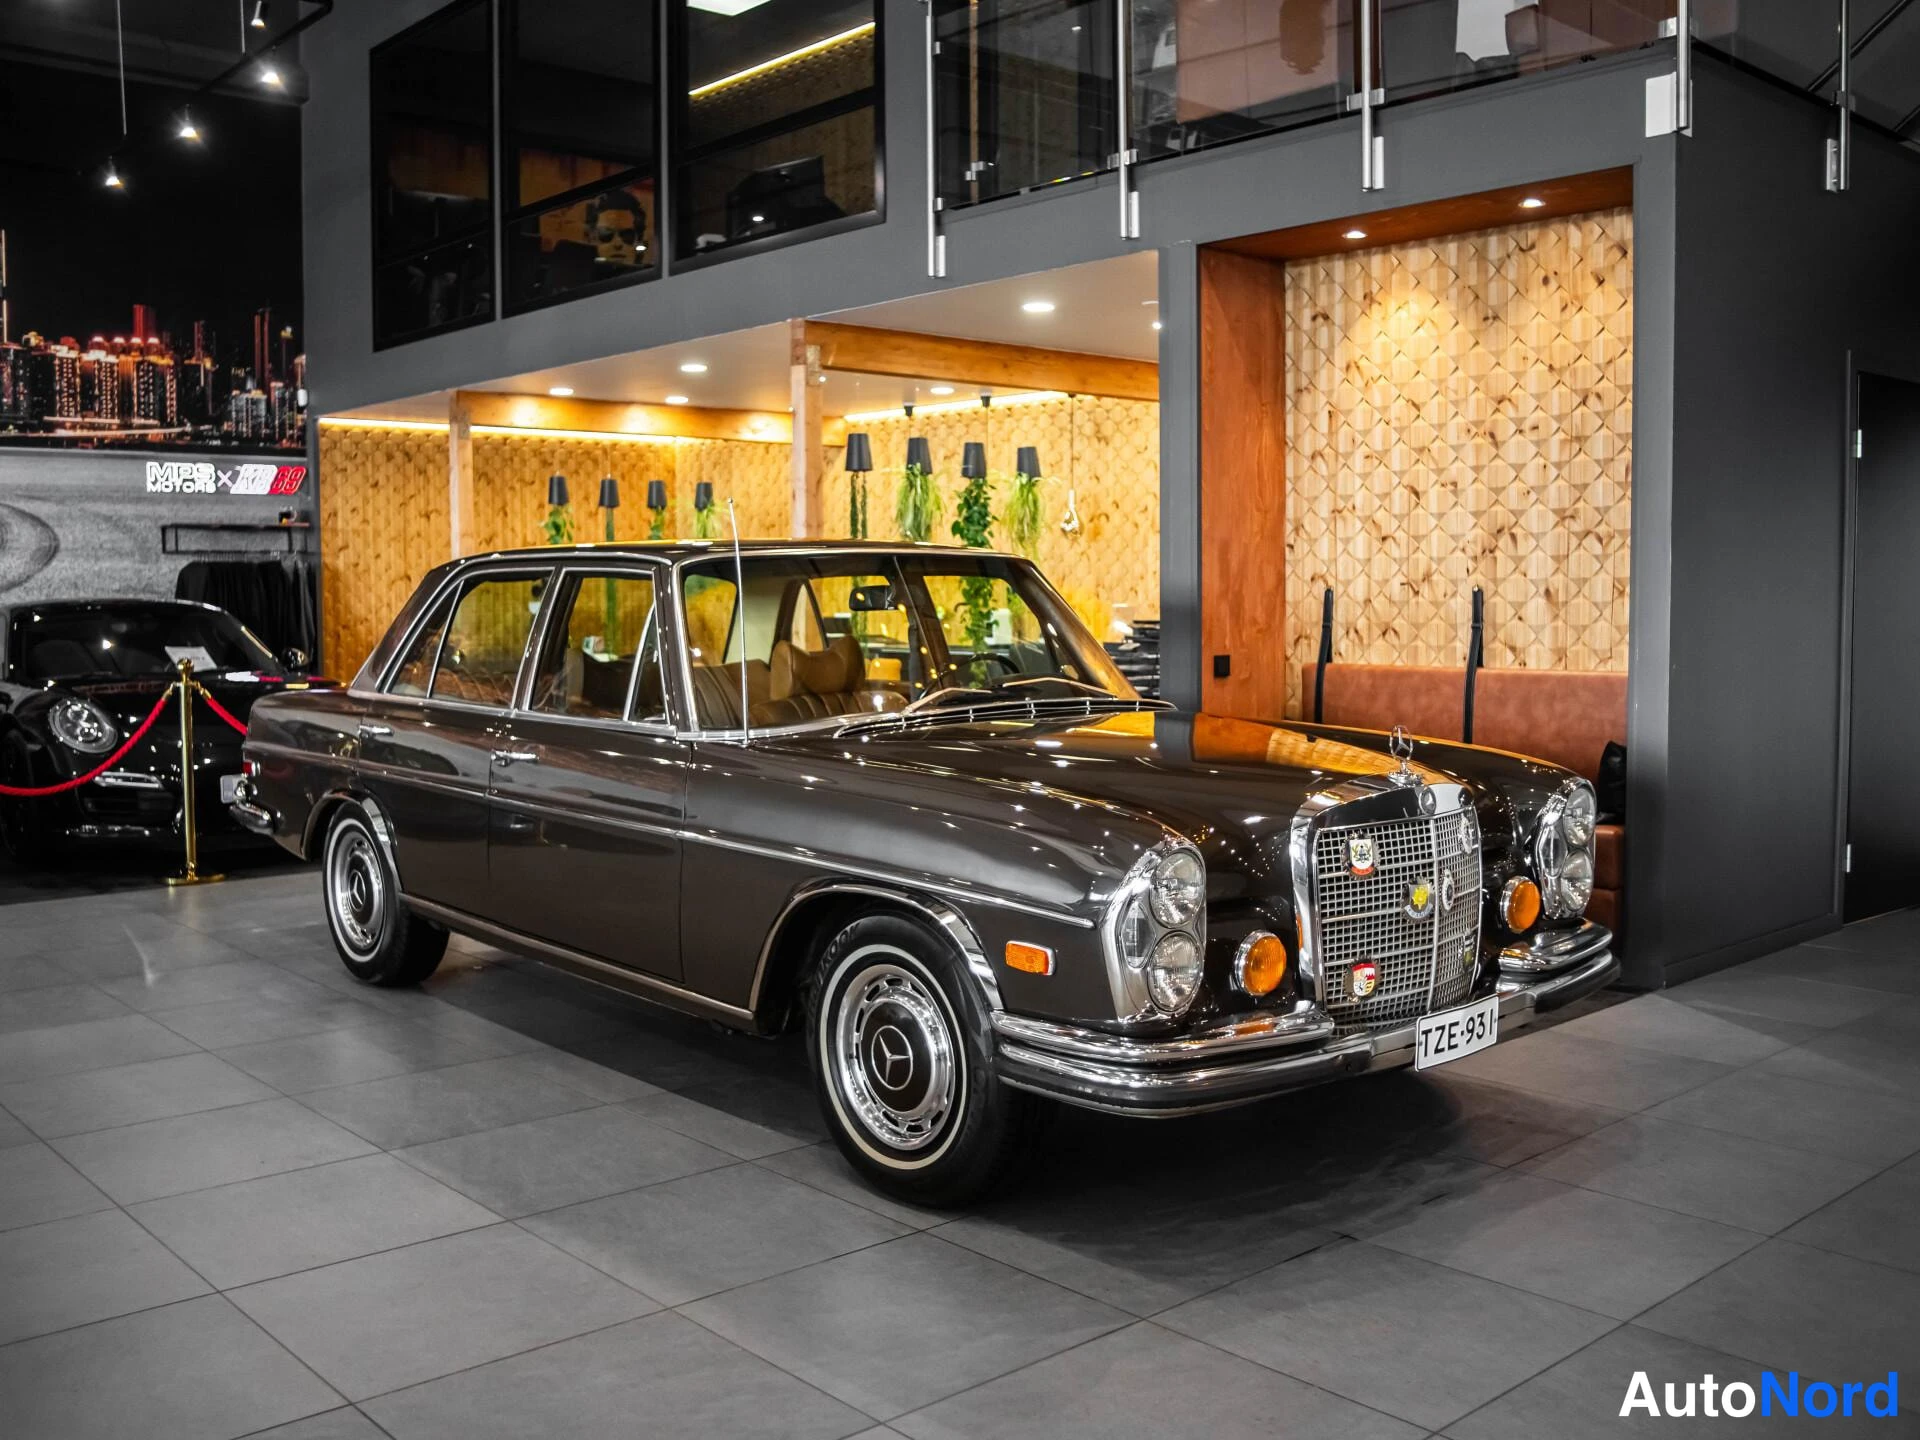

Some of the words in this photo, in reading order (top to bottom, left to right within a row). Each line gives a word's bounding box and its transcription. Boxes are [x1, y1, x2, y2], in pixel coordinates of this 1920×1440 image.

[146, 461, 216, 482] MPS
[146, 480, 217, 494] MOTORS
[1421, 1008, 1494, 1058] TZE-931
